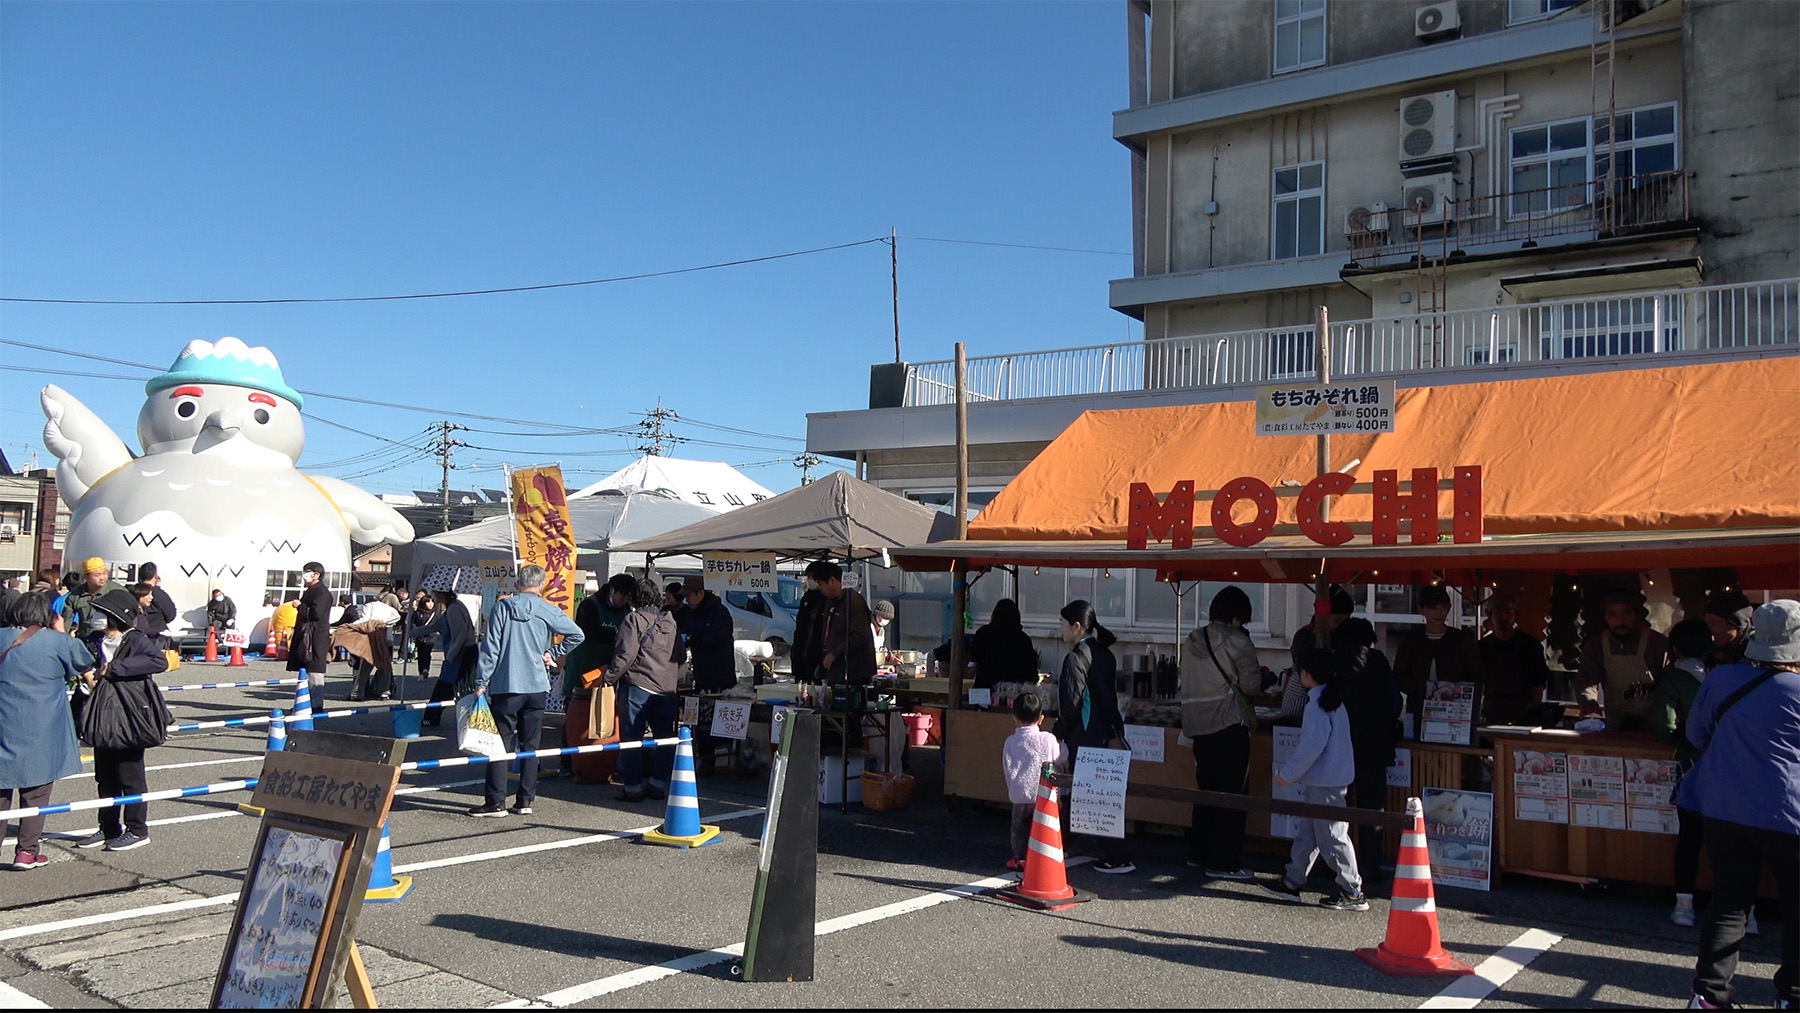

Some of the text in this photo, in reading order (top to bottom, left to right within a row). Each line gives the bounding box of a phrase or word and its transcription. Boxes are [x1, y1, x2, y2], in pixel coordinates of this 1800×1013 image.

[1271, 386, 1379, 407] もちみぞれ鍋
[1356, 407, 1388, 418] 500円
[1356, 419, 1388, 431] 400円
[1127, 464, 1483, 550] MOCHI
[707, 560, 771, 574] 芋もちカレー鍋
[750, 578, 769, 588] 500円
[719, 706, 743, 722] 焼き芋
[263, 767, 383, 813] 食彩工房たてやま
